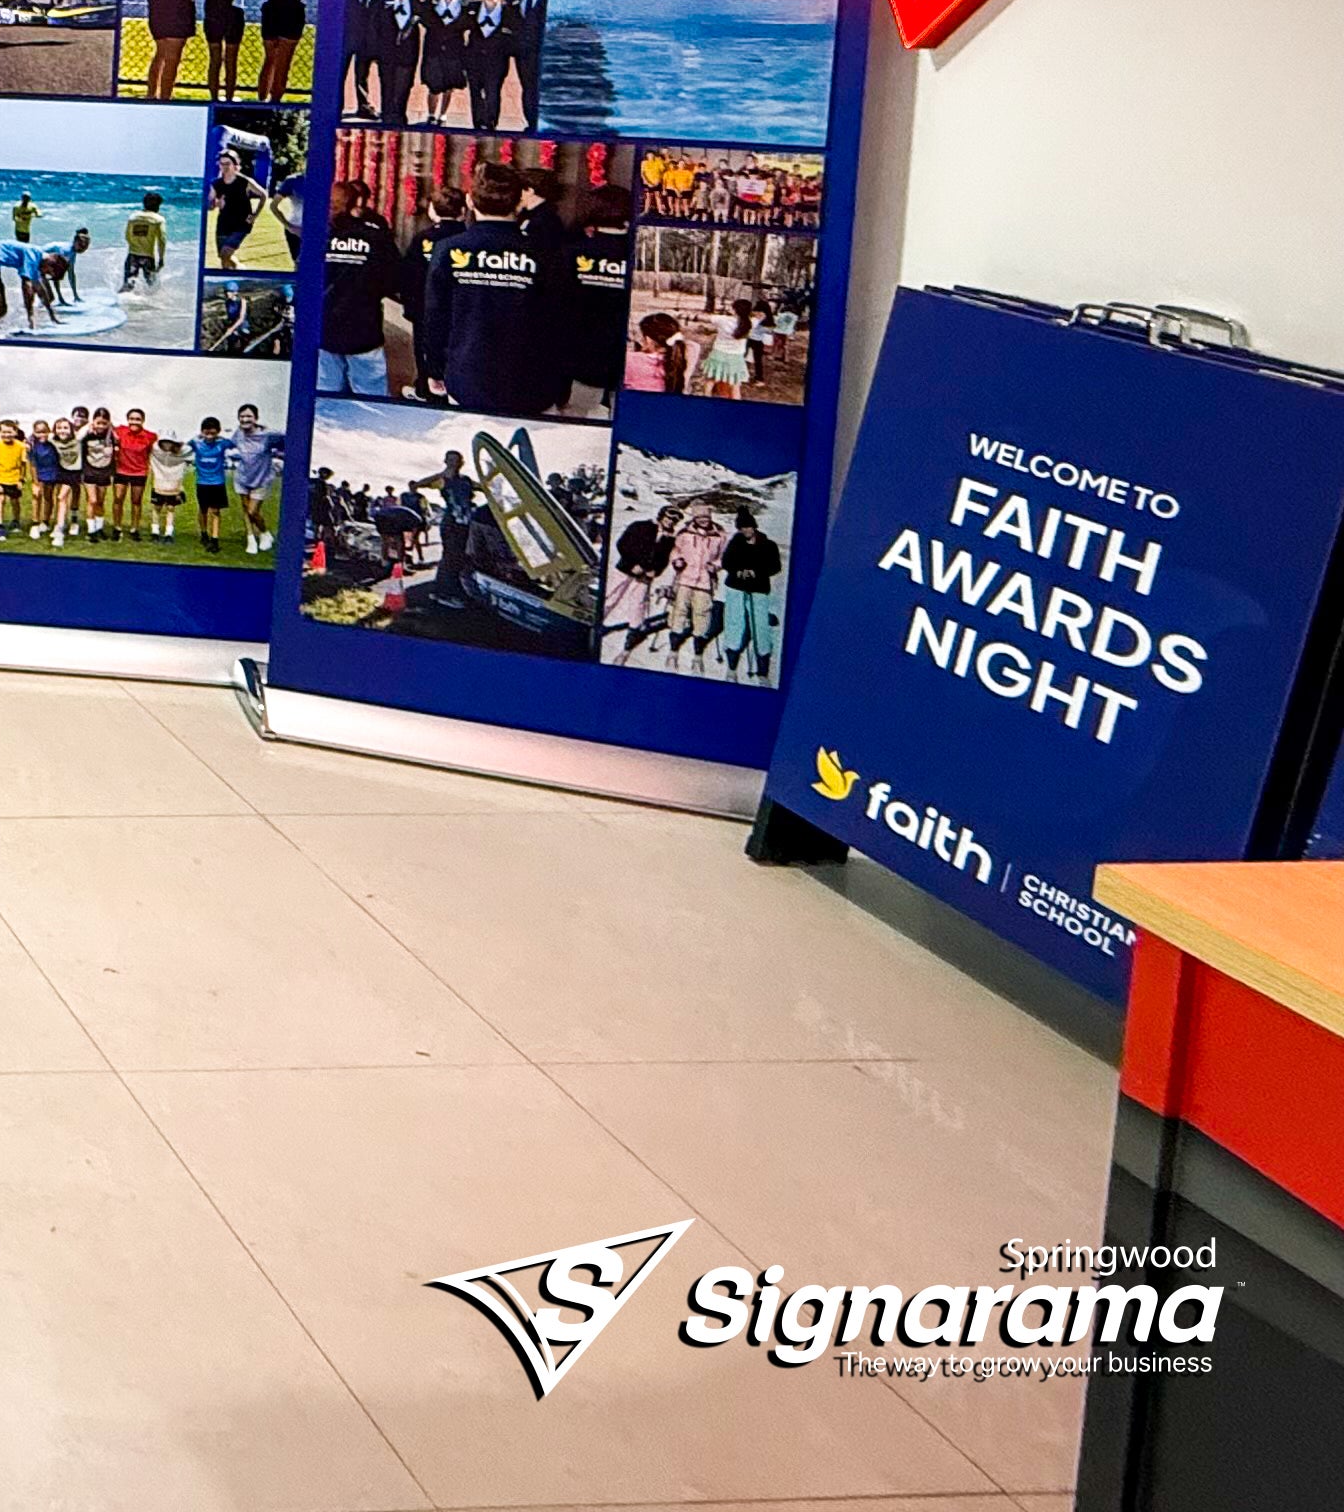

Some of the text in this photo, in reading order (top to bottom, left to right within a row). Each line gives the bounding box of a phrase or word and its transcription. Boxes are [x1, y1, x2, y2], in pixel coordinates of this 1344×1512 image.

[330, 237, 371, 254] faith
[476, 250, 537, 274] faith
[969, 432, 1180, 519] WELCOME TO
[949, 477, 1163, 596] FAITH
[878, 529, 1209, 695] AWARDS
[904, 607, 1139, 745] NIGHT
[864, 781, 994, 885] faith
[1018, 890, 1115, 957] SCHOOL
